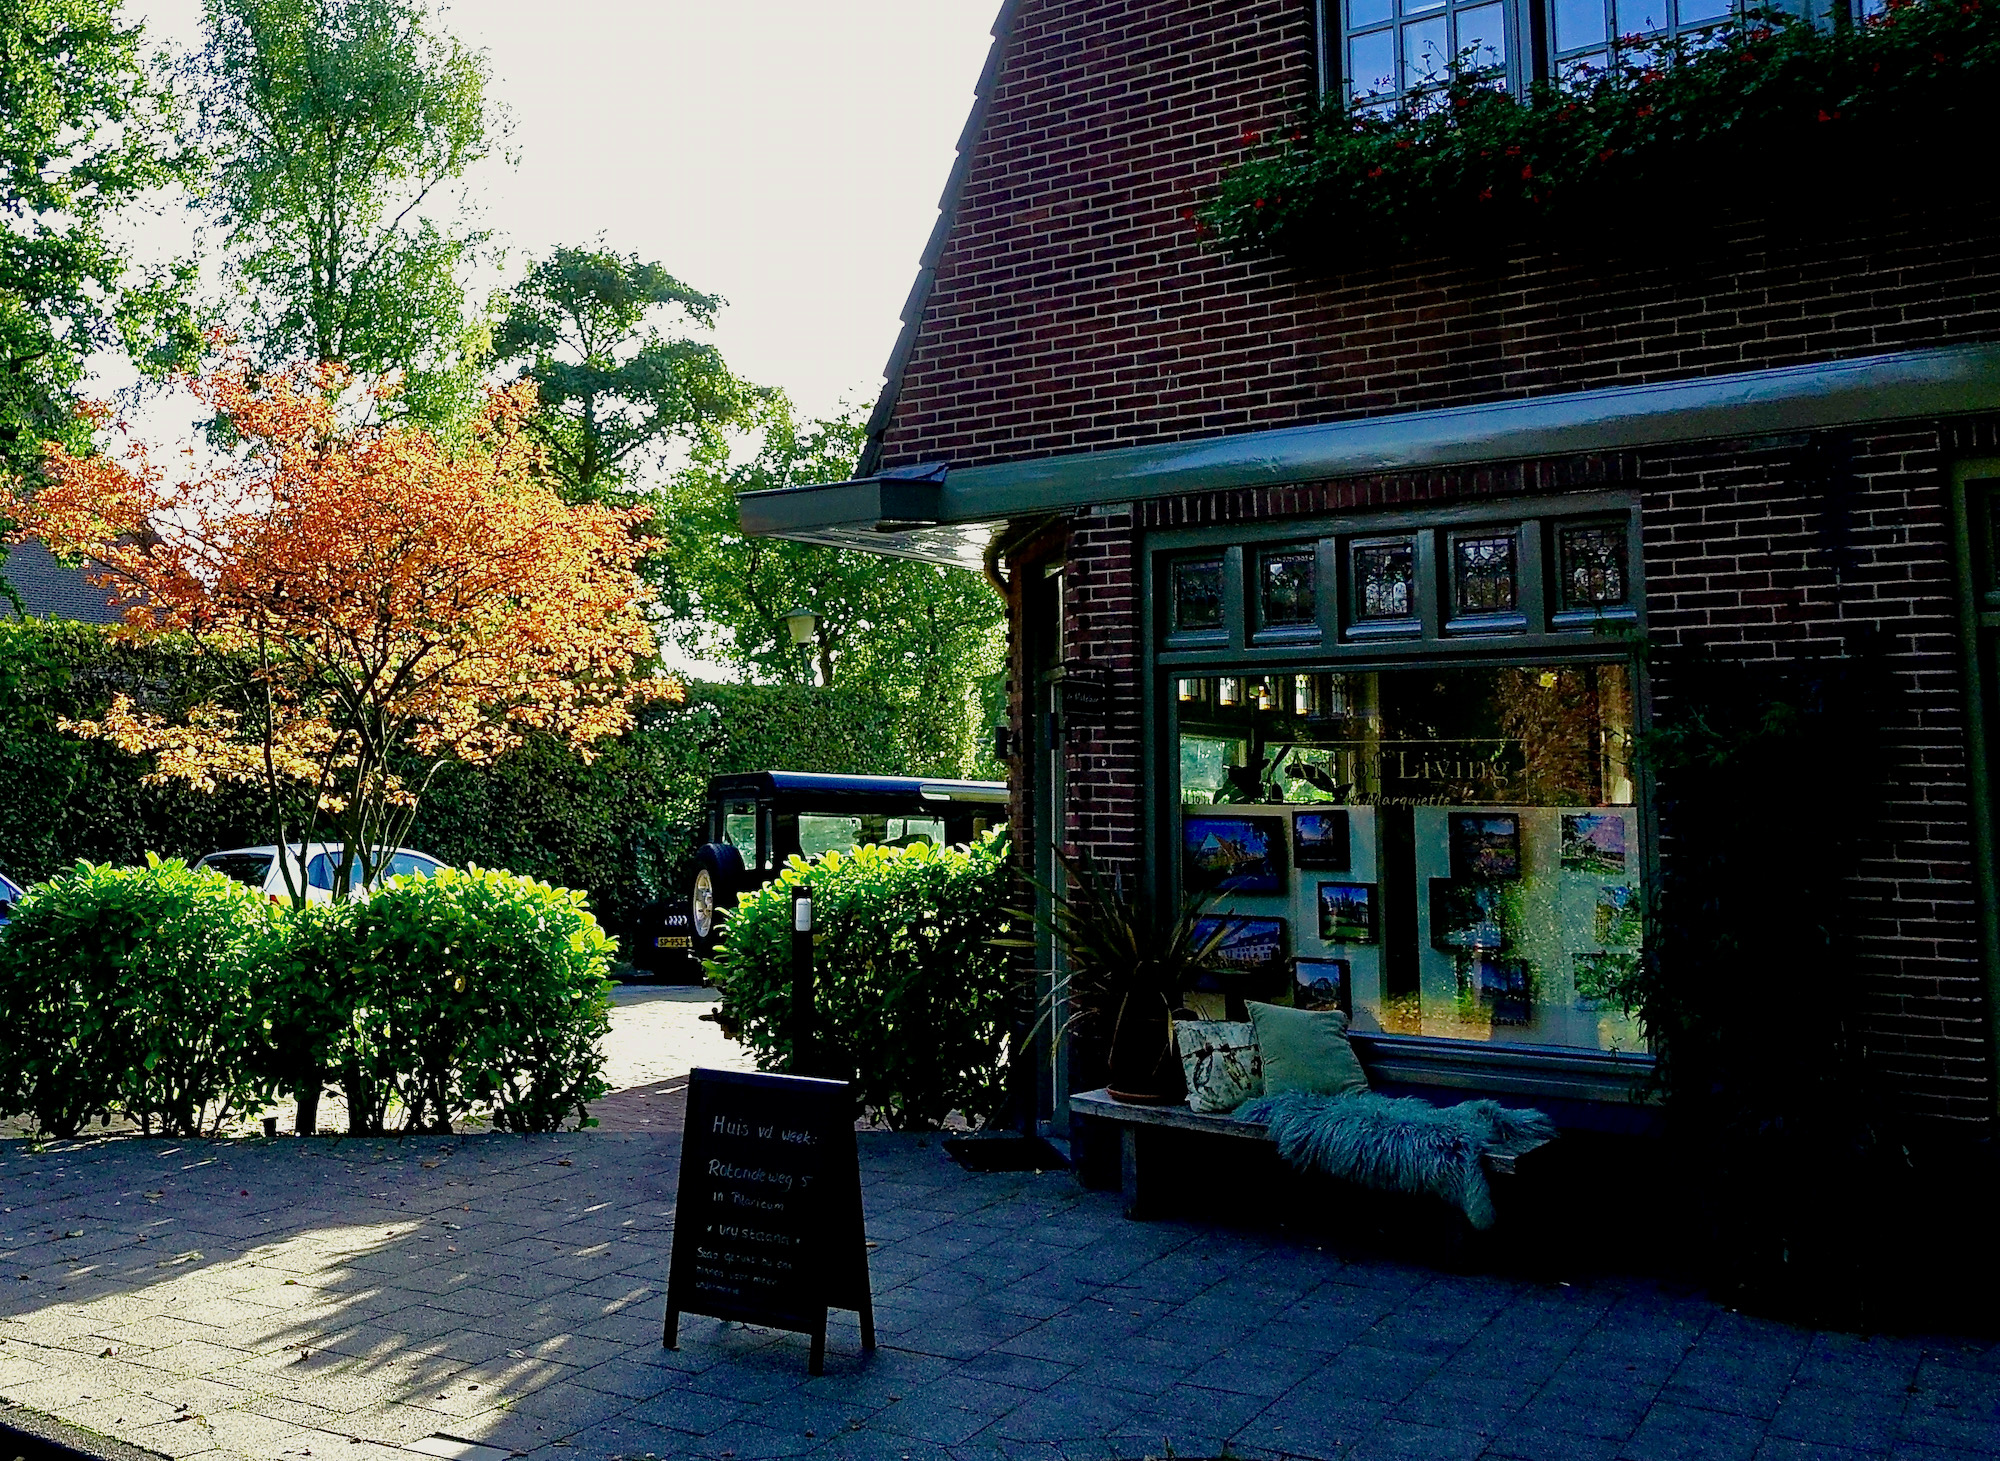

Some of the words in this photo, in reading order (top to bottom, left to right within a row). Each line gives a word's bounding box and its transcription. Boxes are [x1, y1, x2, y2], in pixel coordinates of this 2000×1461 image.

[1285, 750, 1336, 779] Art
[1351, 751, 1384, 779] of
[1397, 750, 1510, 789] Living
[1365, 791, 1452, 811] Marquiette
[712, 1115, 750, 1137] Huis
[758, 1125, 774, 1139] vd
[800, 1175, 814, 1188] 5
